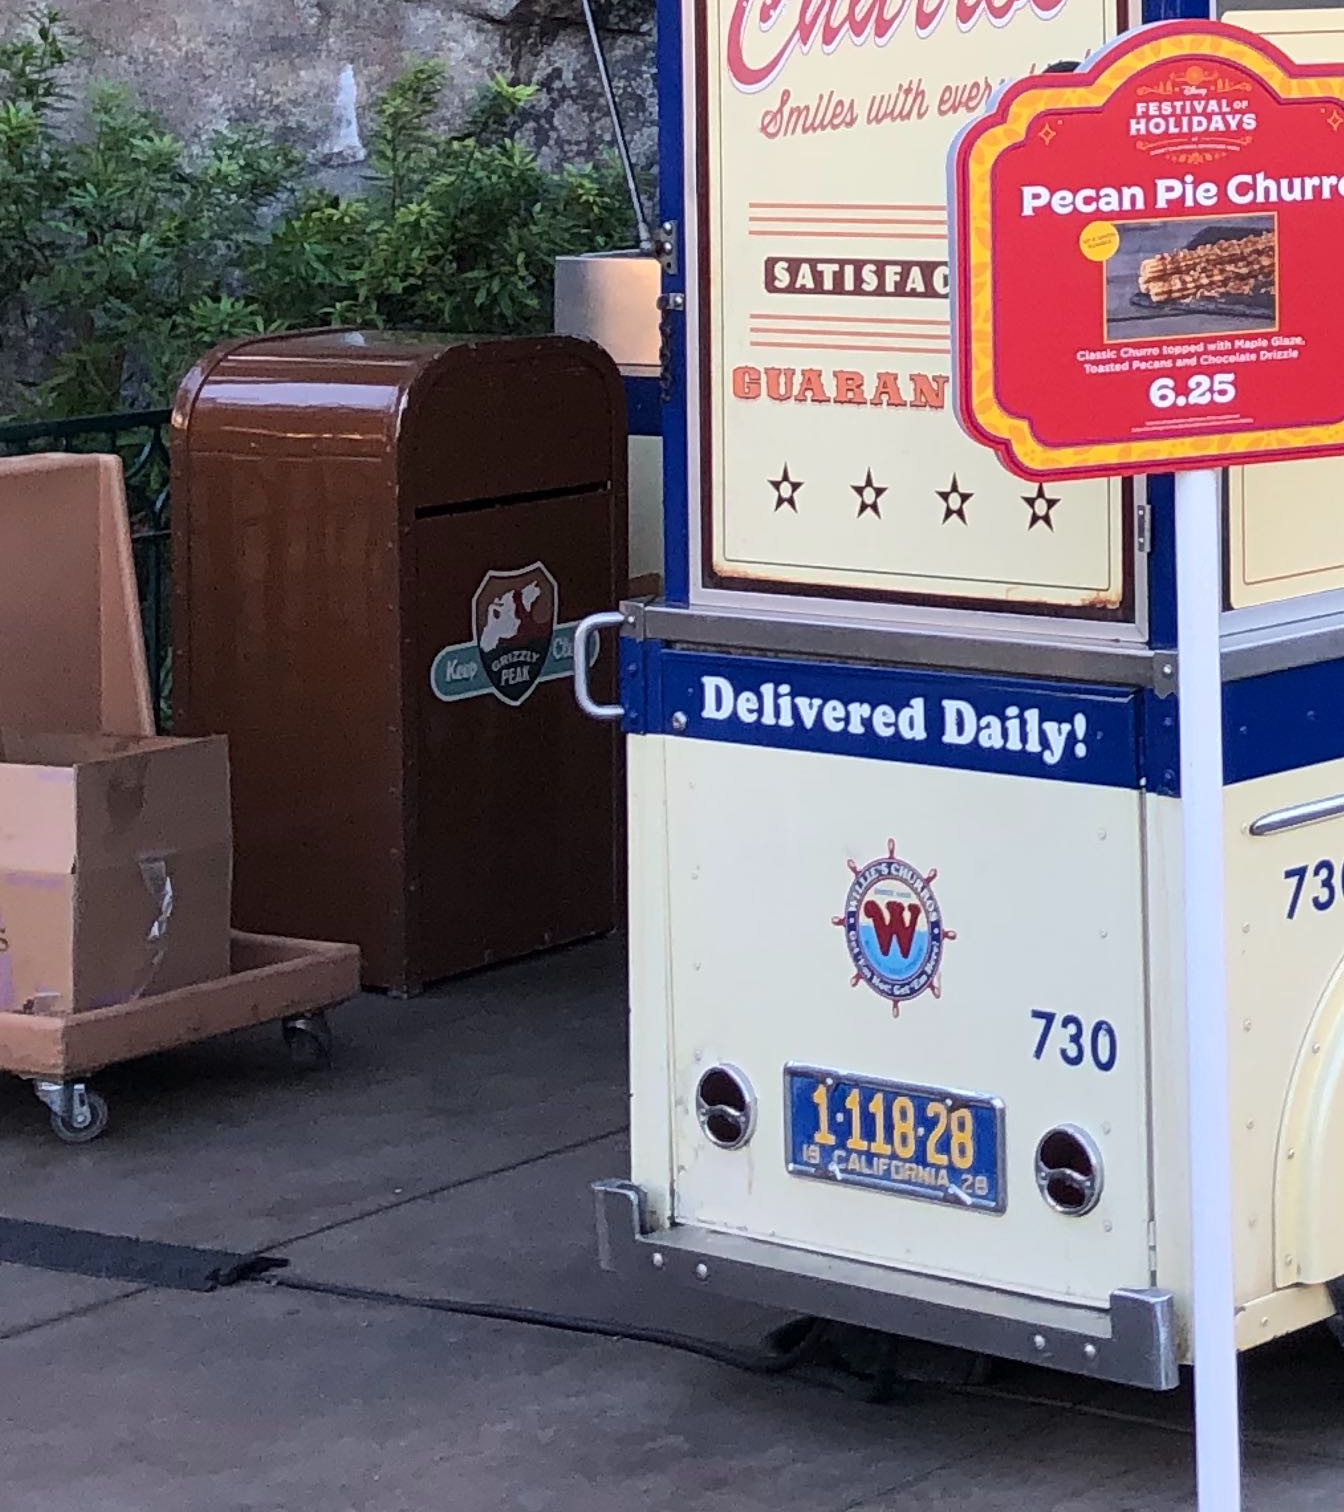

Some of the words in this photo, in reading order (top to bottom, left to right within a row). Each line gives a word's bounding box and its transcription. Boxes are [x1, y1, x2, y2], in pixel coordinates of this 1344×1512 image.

[760, 89, 859, 139] Smiles
[867, 77, 930, 127] with
[937, 76, 1005, 117] ever
[1129, 113, 1257, 136] HOLIDAYS
[1136, 98, 1231, 117] FESTIVAL
[1233, 100, 1249, 110] OF
[1021, 183, 1146, 217] Pecan
[1154, 174, 1219, 208] Pie
[1077, 348, 1117, 361] Classic
[1120, 346, 1160, 358] Churro
[1162, 343, 1205, 356] topped
[1207, 340, 1231, 351] with
[1234, 338, 1268, 350] Maple
[1084, 361, 1130, 374] Toasted
[1132, 359, 1173, 370] Pecans
[1176, 356, 1197, 367] and
[1200, 354, 1257, 365] Chocolate
[1260, 349, 1299, 361] Drizzle
[732, 366, 949, 410] GUARAN
[1149, 372, 1236, 408] 6.25
[446, 659, 477, 682] Keep
[491, 650, 541, 672] GRIZZLY
[500, 666, 530, 687] PEAK
[701, 676, 927, 742] Delivered
[943, 699, 1088, 765] Daily!
[891, 864, 938, 922] CHURROS
[864, 900, 921, 959] W
[1030, 1009, 1117, 1072] 730
[833, 1150, 950, 1188] CALIFORNIA
[961, 1174, 989, 1196] 28
